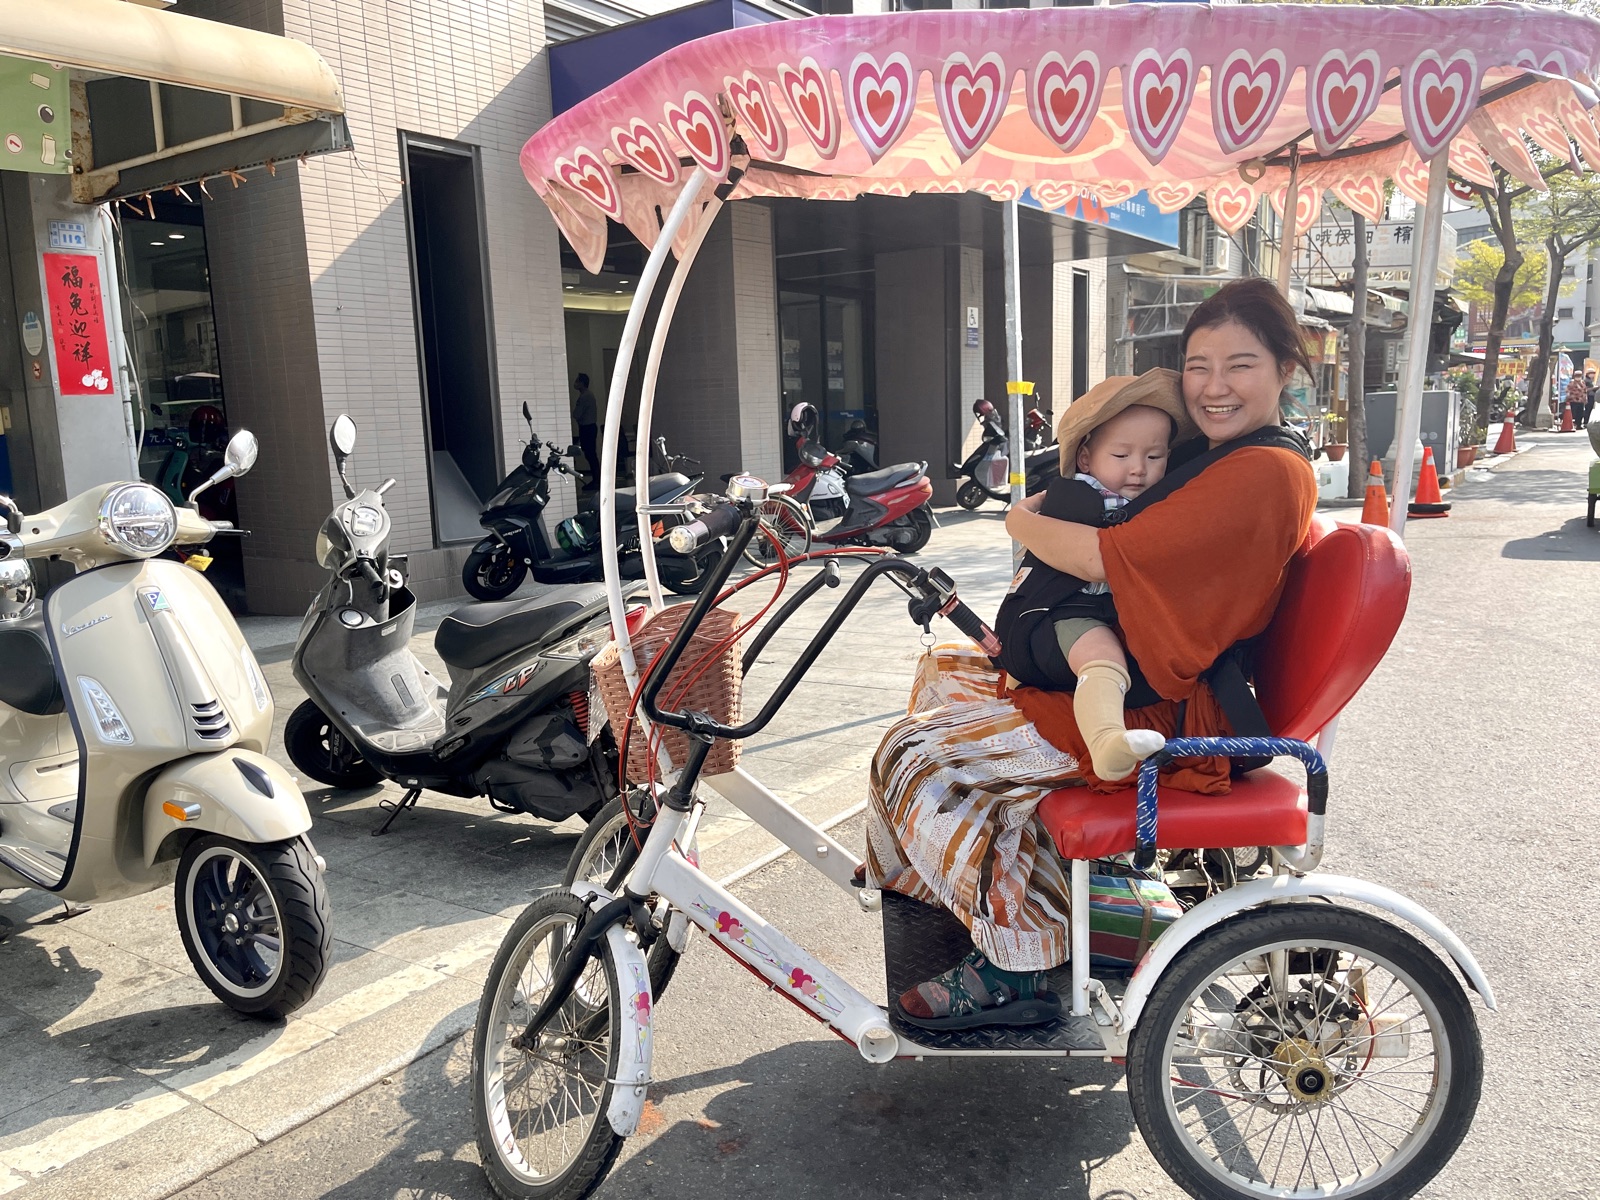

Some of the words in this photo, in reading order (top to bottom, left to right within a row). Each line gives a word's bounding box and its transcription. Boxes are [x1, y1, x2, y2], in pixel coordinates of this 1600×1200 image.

[62, 233, 82, 244] 112
[61, 265, 94, 370] 福兔迎祥
